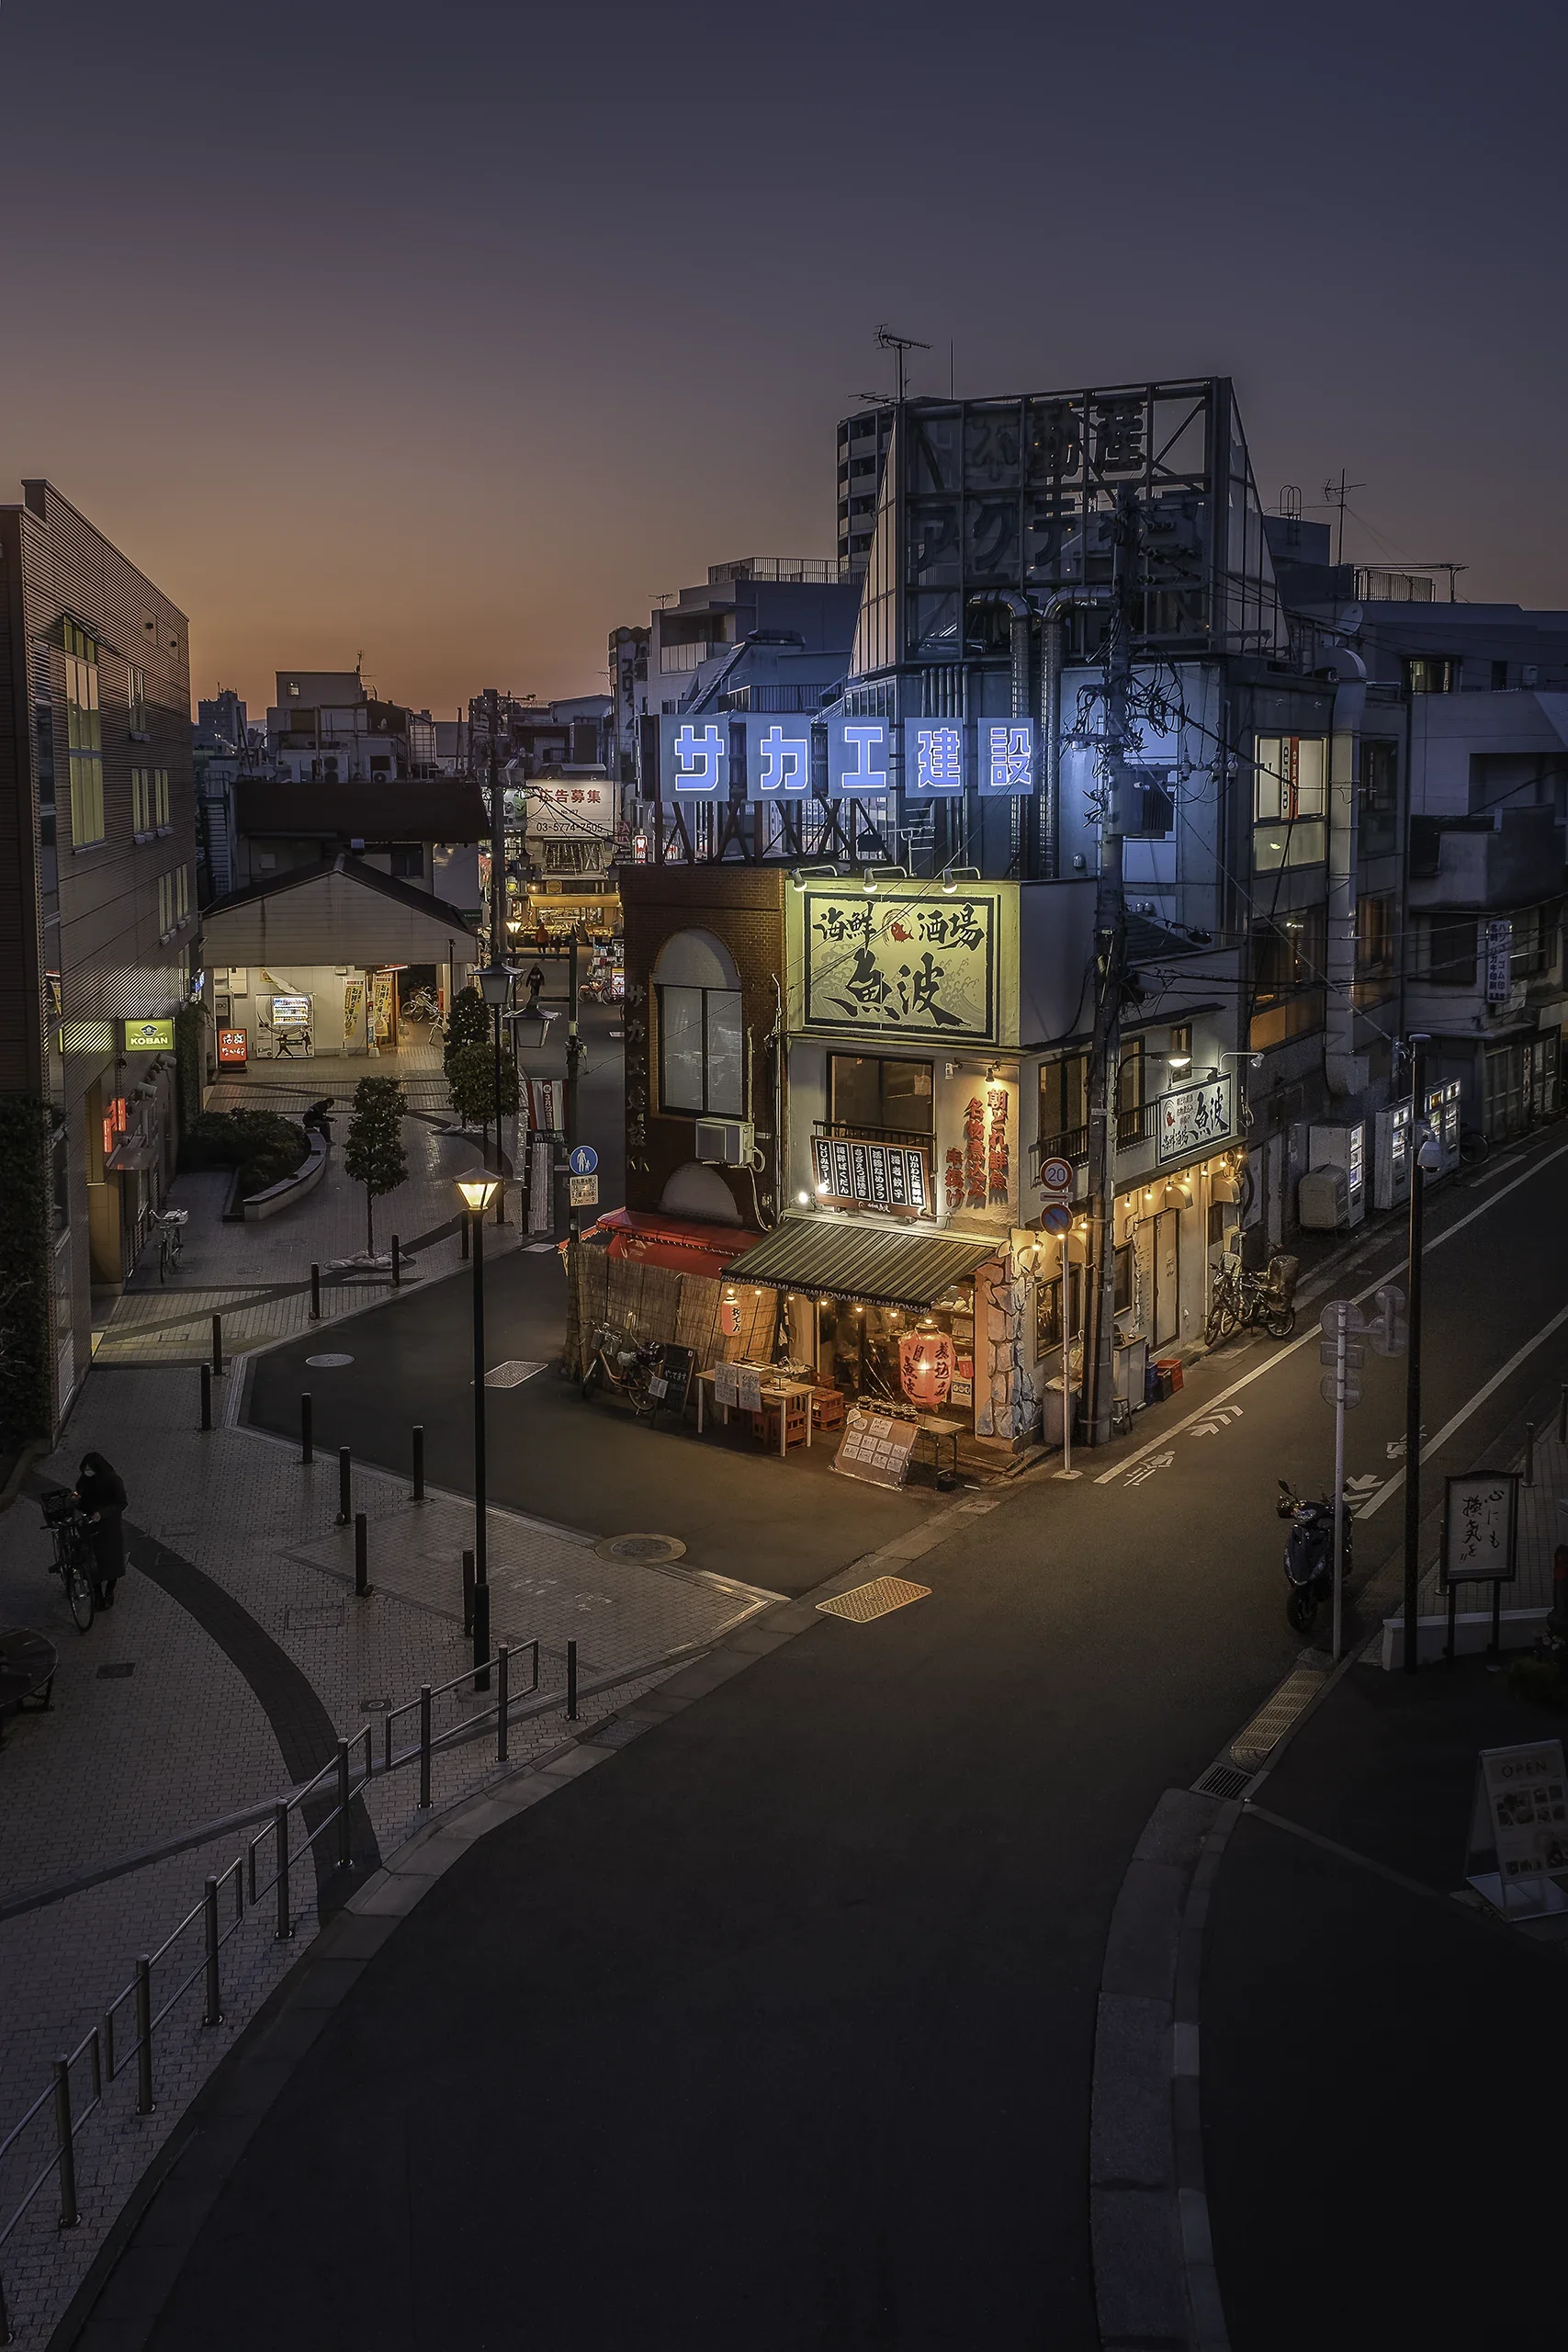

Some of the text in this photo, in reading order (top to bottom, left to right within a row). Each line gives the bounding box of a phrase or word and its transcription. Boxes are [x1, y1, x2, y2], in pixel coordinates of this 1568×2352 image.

[673, 724, 1032, 792] サカエ建設
[539, 788, 601, 804] 広告募集
[812, 901, 987, 951] 海鮮 酒場
[823, 948, 971, 1028] 魚波
[130, 1036, 168, 1046] KOBAN
[964, 1097, 987, 1200] 名物煮込み
[987, 1089, 1010, 1191] 朝どれ鮮魚
[945, 1147, 965, 1208] 串揚げ
[1047, 1167, 1066, 1182] 20
[721, 1274, 736, 1283] FISH
[750, 1278, 789, 1291] UONAMI
[818, 1289, 861, 1303] UONAMI
[889, 1301, 931, 1314] UONAMI
[1502, 1760, 1547, 1778] OPEN
